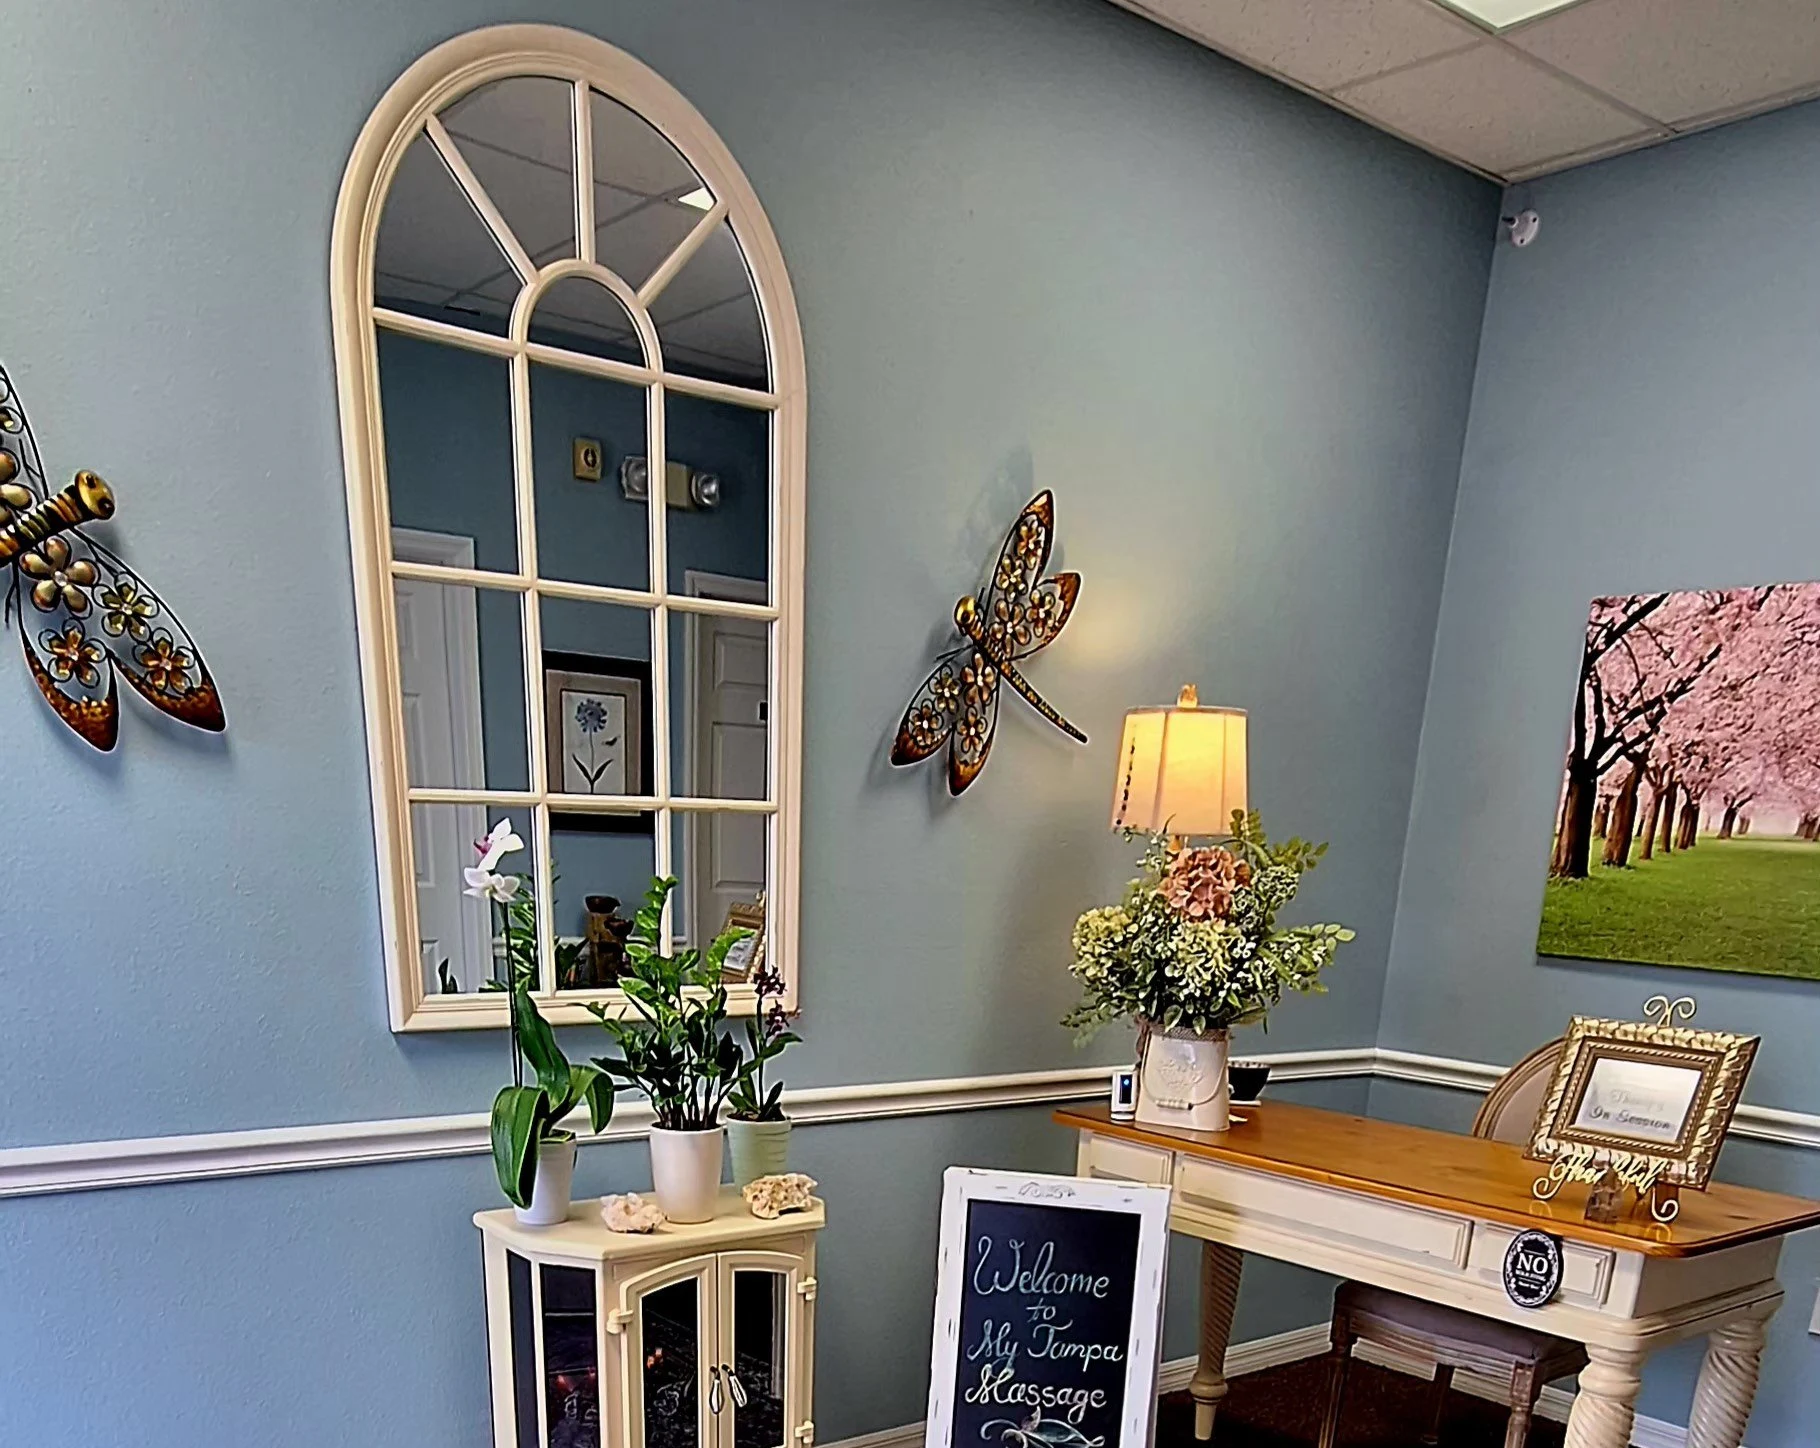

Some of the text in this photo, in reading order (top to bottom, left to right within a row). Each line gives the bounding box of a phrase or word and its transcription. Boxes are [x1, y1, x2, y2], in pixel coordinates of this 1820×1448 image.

[1589, 1105, 1671, 1130] In Session
[973, 1235, 1110, 1298] Welcome
[1516, 1252, 1549, 1274] NO
[1026, 1297, 1057, 1323] to
[966, 1318, 1124, 1378] My Tampa
[964, 1363, 1108, 1425] Massage
